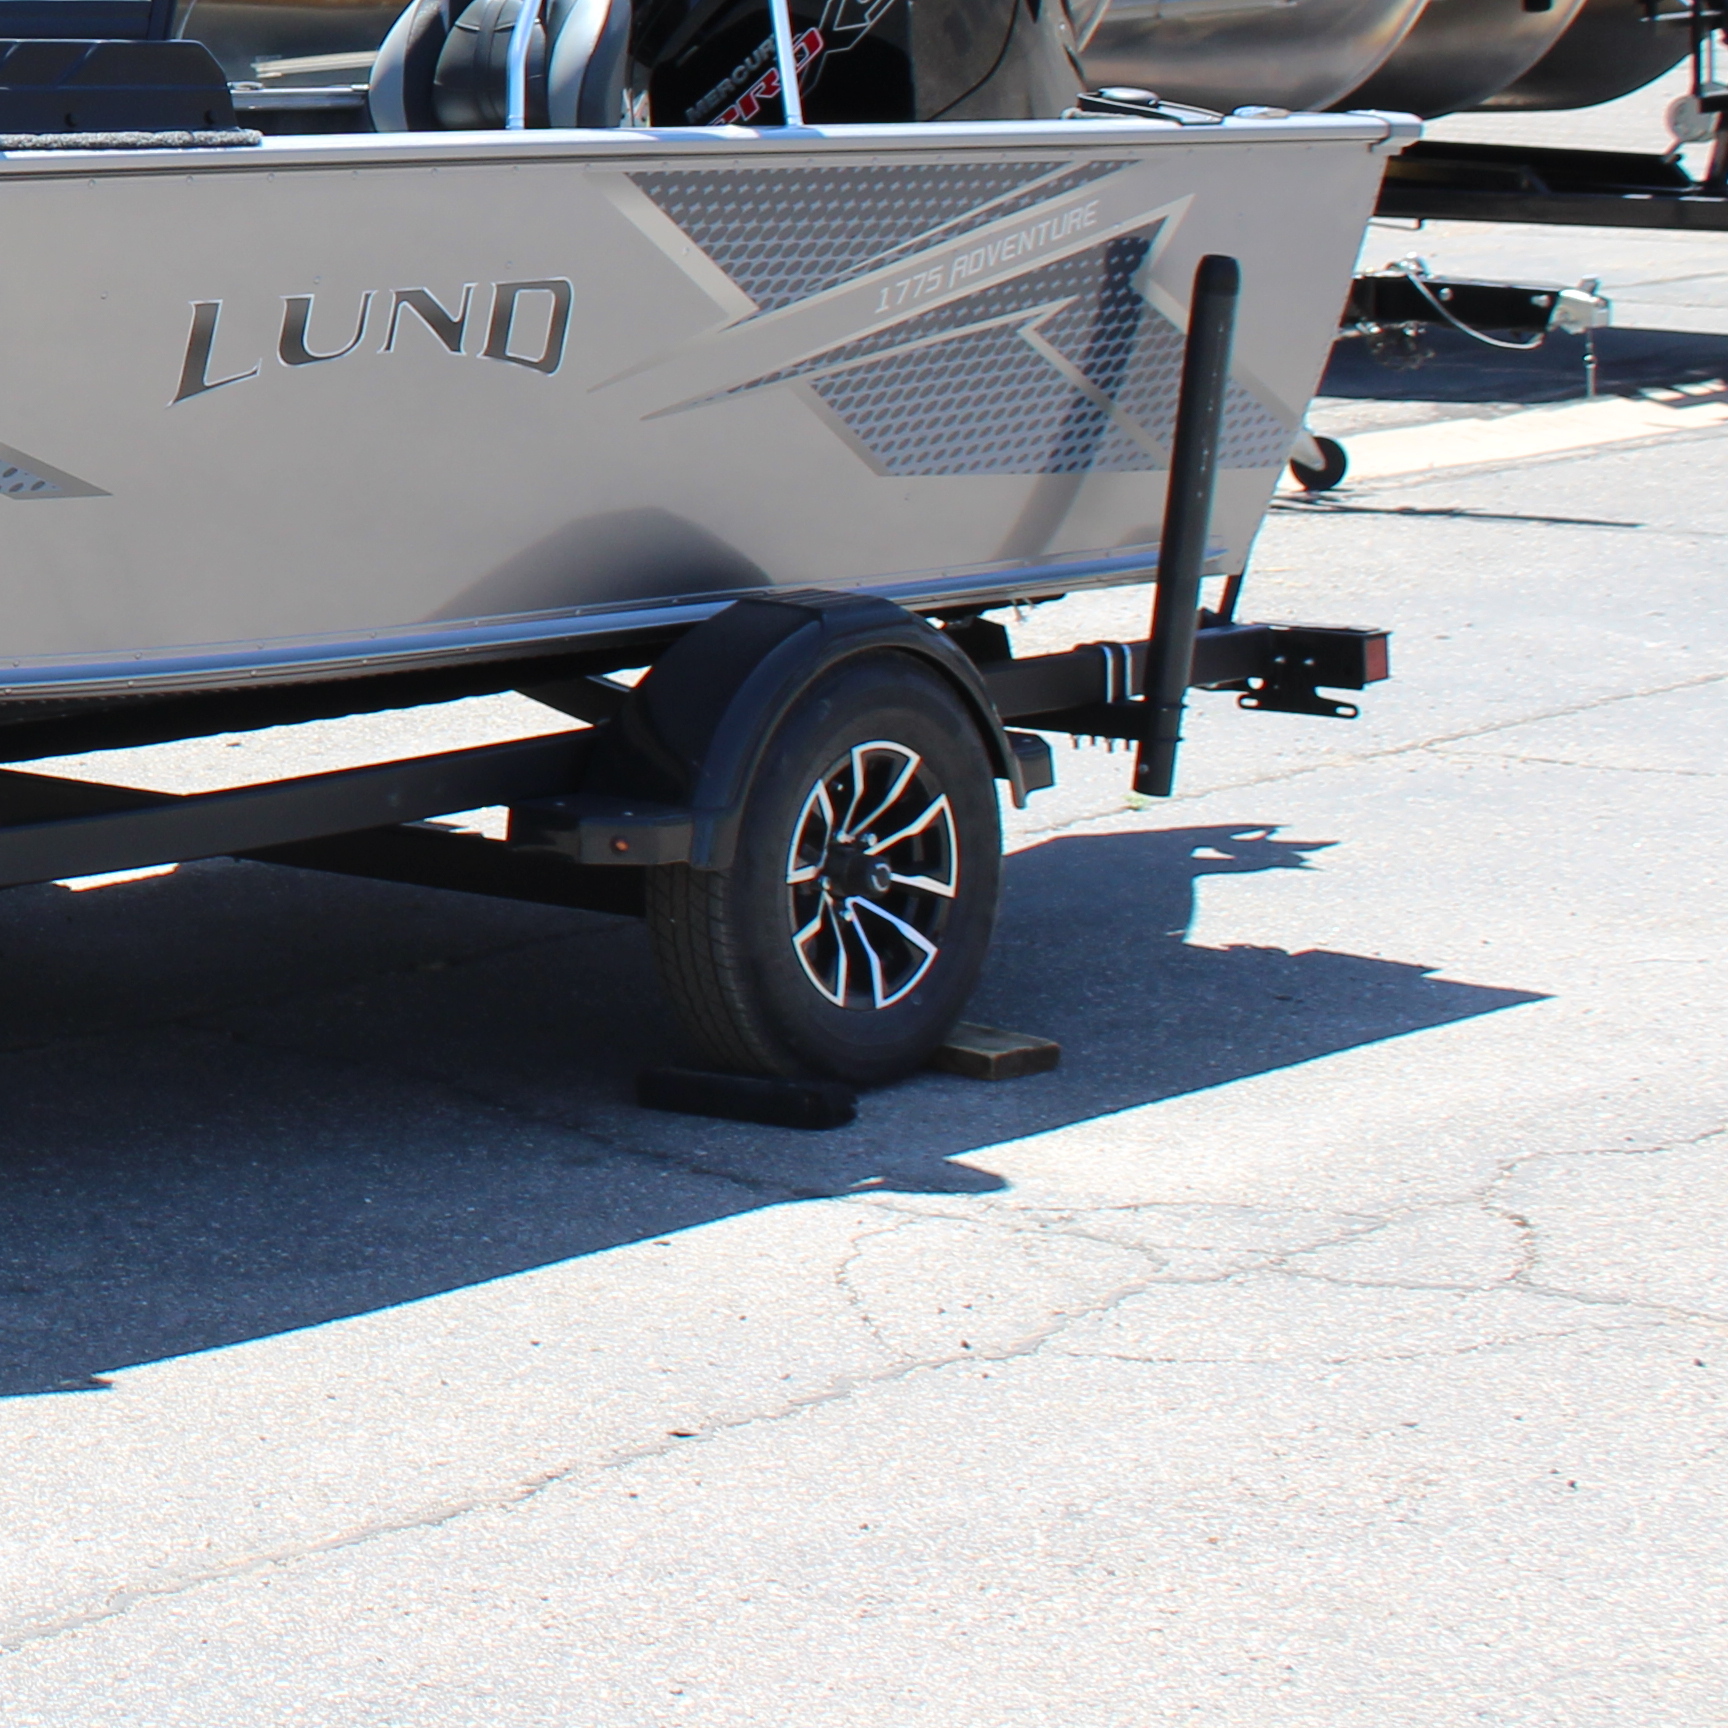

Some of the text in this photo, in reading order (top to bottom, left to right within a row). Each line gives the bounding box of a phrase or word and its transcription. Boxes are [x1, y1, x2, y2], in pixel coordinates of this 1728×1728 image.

[684, 34, 776, 124] MERCUR
[874, 199, 1102, 315] 1775 ADVENTURE
[167, 274, 575, 407] LUND
